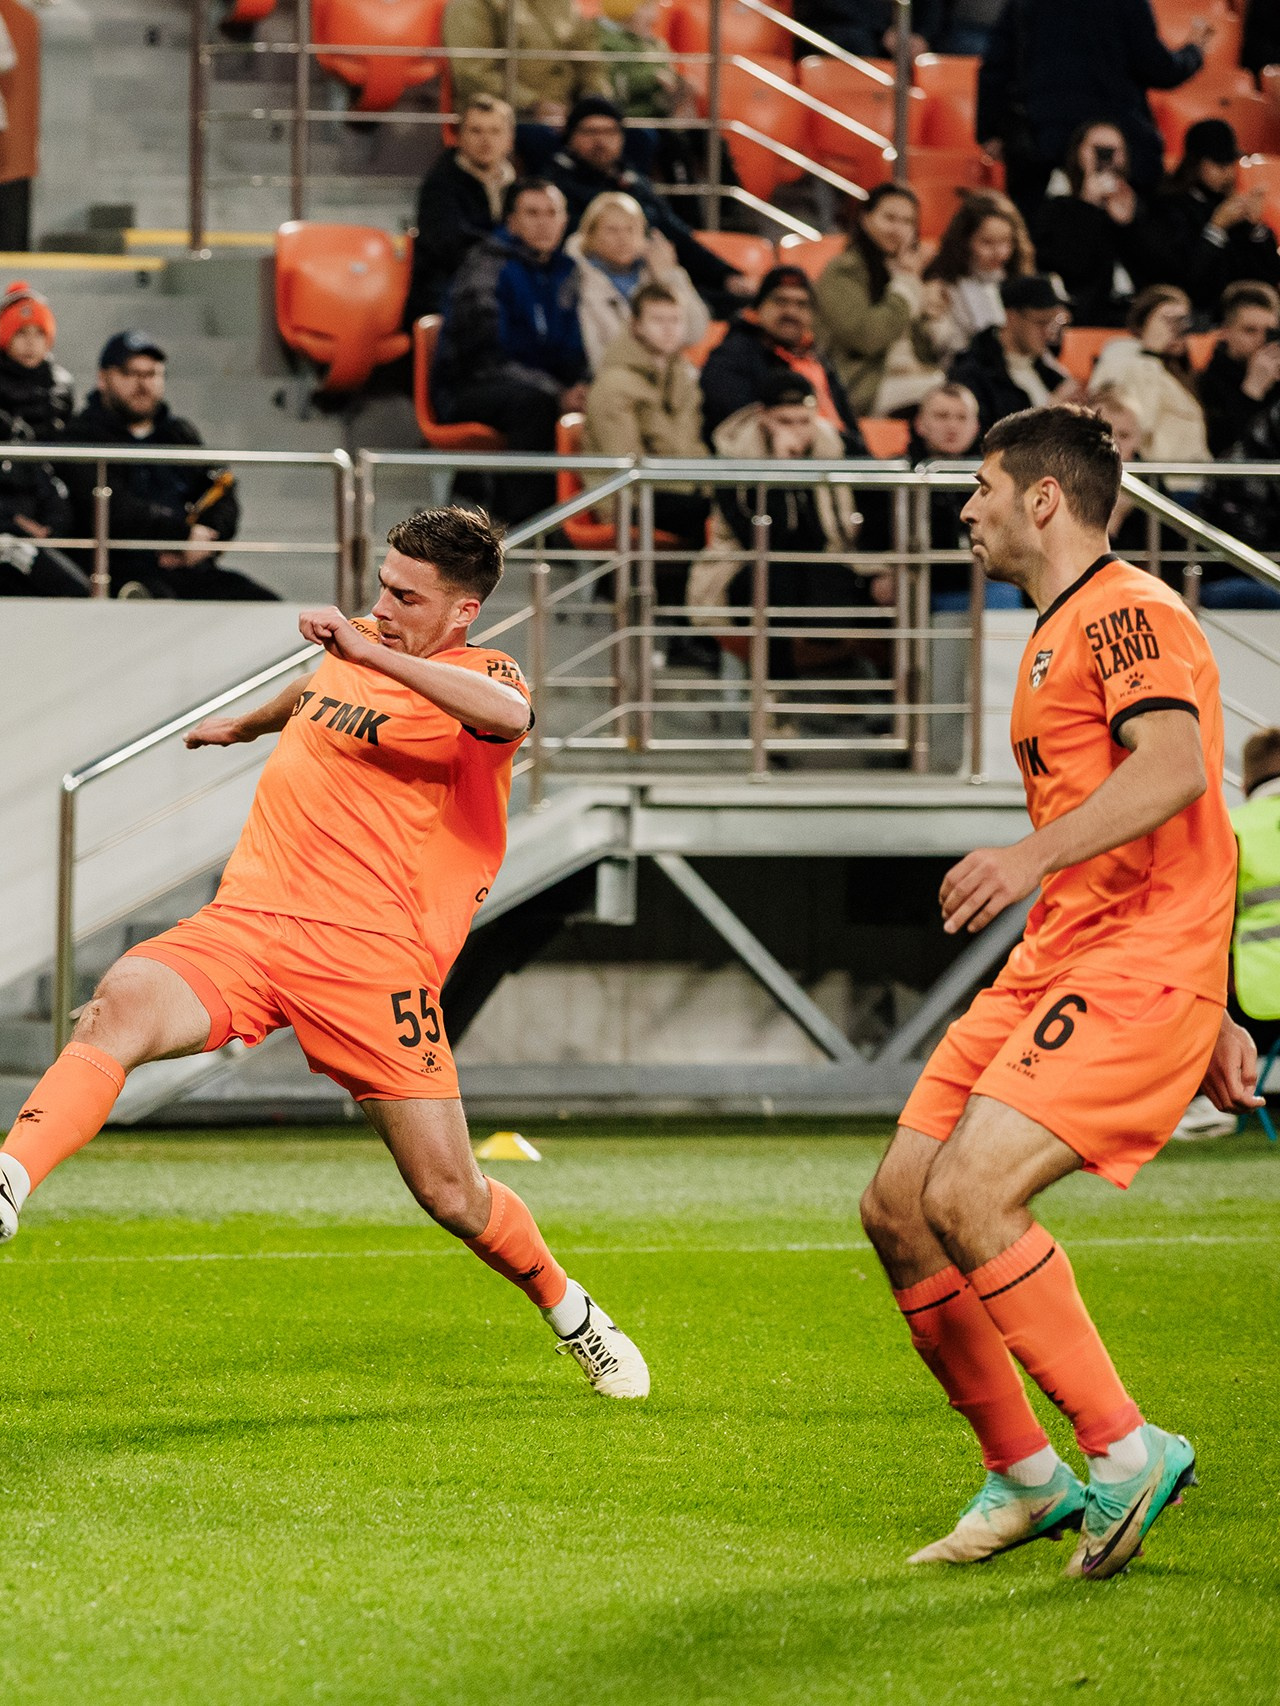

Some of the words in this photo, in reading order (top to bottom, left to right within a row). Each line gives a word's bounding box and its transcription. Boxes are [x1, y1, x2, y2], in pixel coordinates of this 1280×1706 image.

[1085, 606, 1153, 652] SIMA
[1094, 633, 1160, 681] LAND
[1120, 685, 1153, 698] KELME
[390, 988, 441, 1048] 55
[1033, 993, 1087, 1051] 6
[420, 1066, 442, 1074] KELME
[1006, 1061, 1036, 1080] KELME
